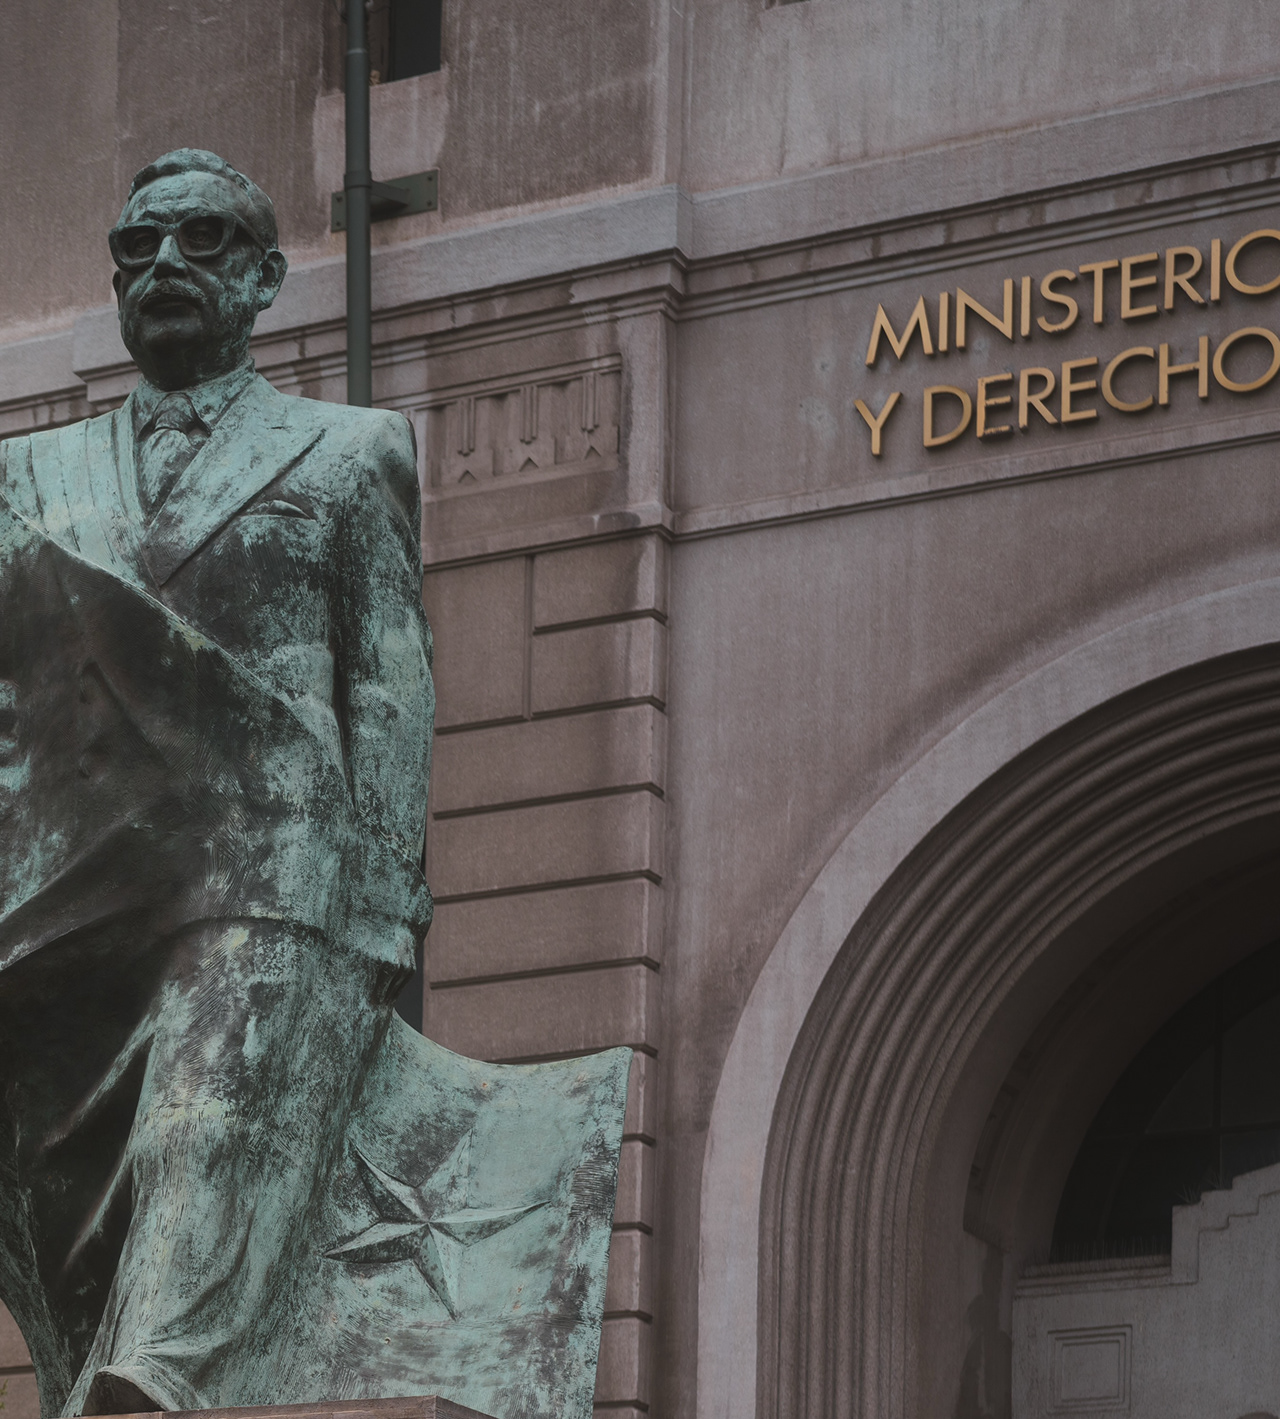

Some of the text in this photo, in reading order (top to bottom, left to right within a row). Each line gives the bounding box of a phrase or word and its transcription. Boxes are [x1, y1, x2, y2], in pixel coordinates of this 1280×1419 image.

[864, 228, 1280, 366] MINISTERIO
[853, 326, 1280, 456] Y DERECHO
